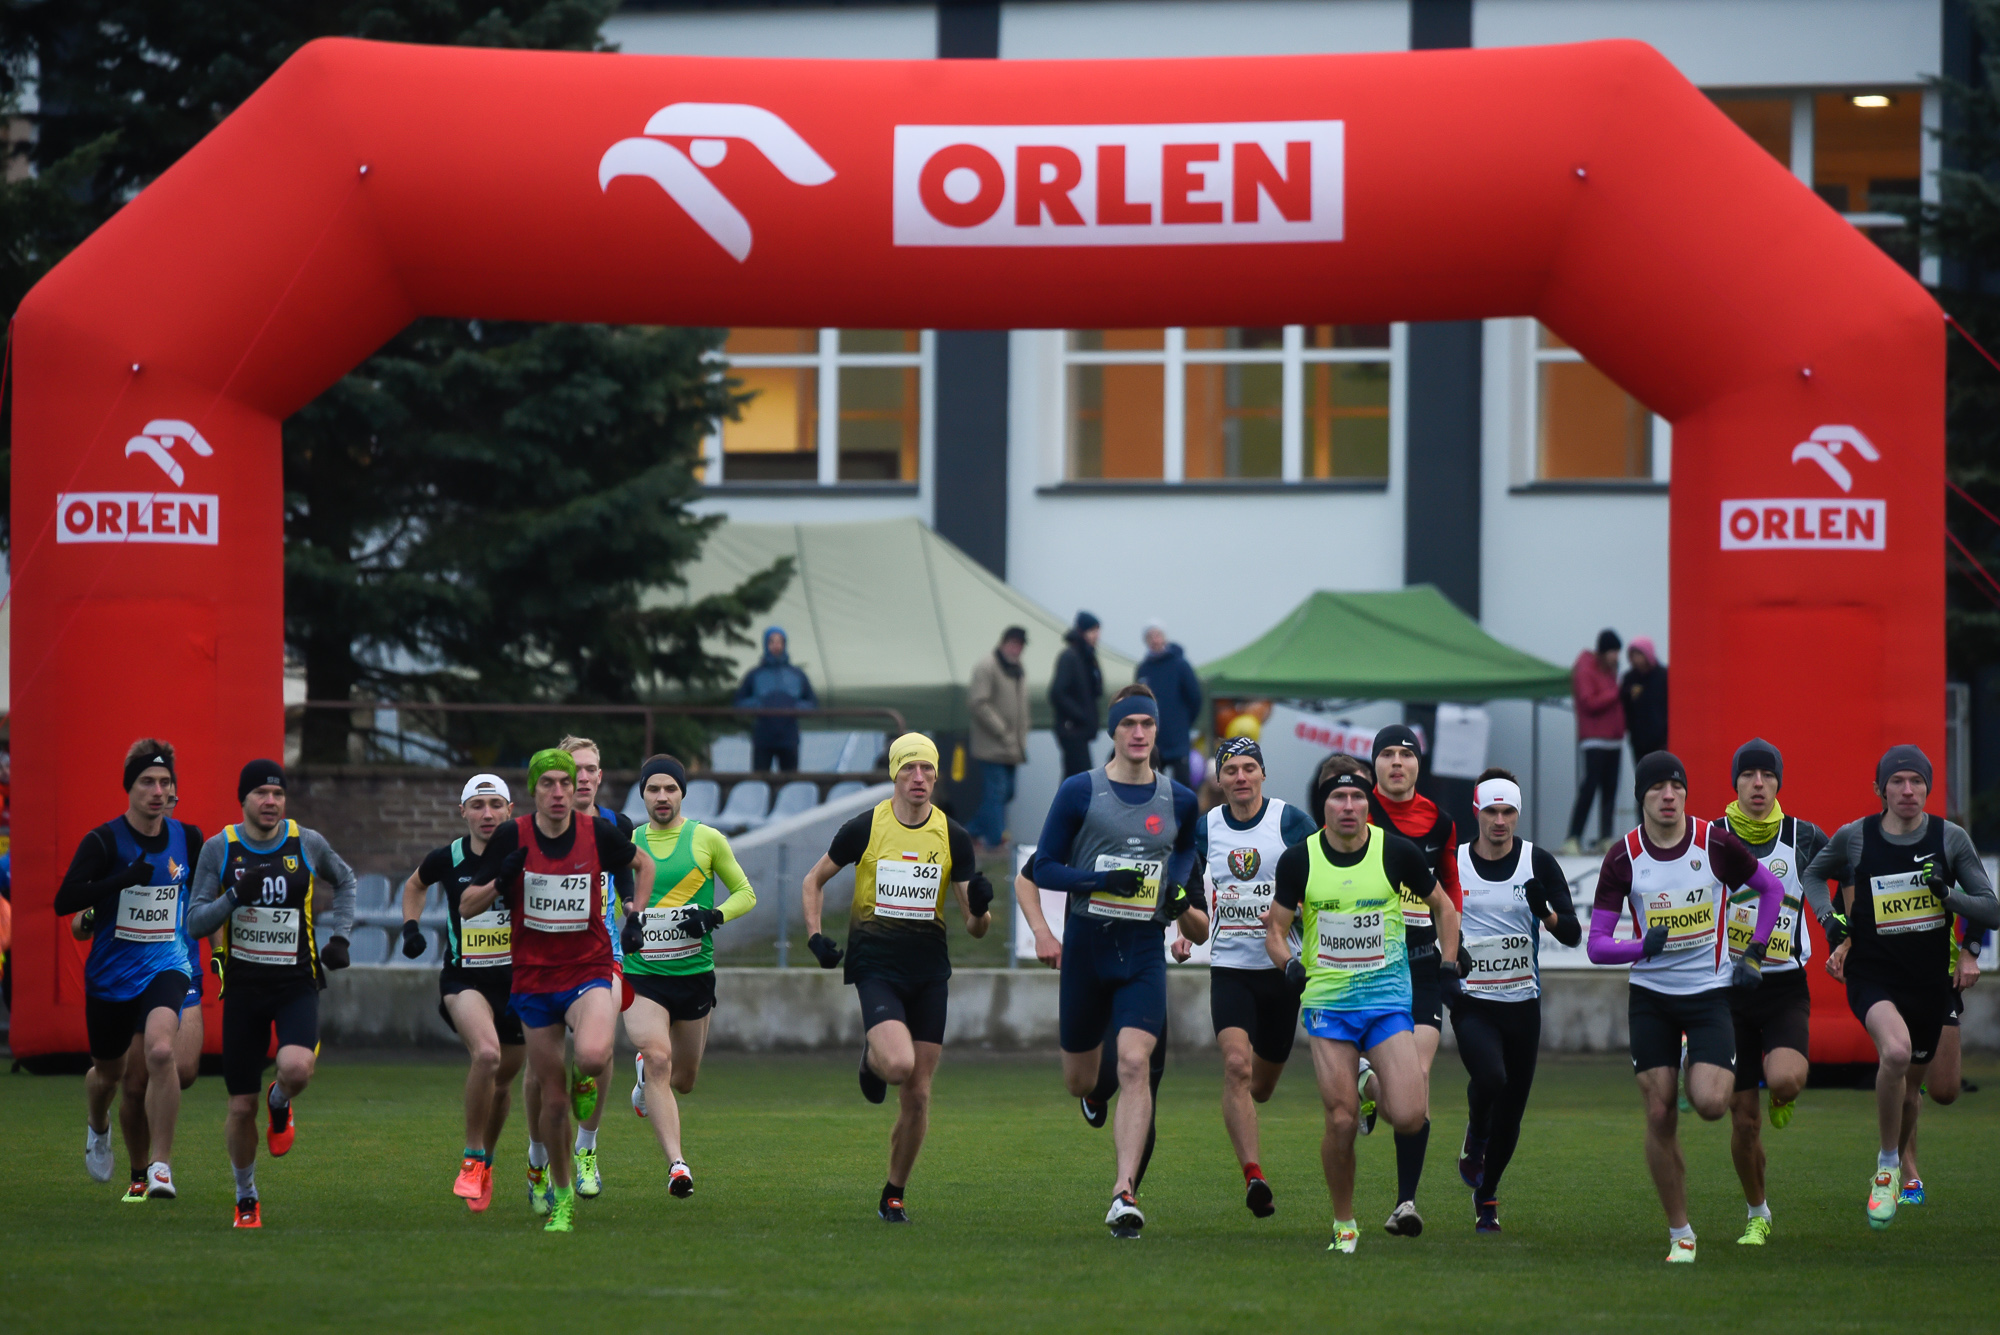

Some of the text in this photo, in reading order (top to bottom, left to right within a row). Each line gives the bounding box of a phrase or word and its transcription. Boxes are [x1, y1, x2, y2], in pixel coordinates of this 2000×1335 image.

[917, 139, 1312, 229] ORLEN
[64, 500, 208, 536] ORLEN
[1729, 507, 1875, 542] ORLEN
[912, 865, 938, 880] 362
[252, 876, 288, 906] 09
[560, 877, 587, 891] 475
[878, 883, 937, 900] KUJAWSKI
[1252, 883, 1271, 897] 48
[155, 887, 176, 901] 250
[1685, 888, 1704, 904] 47
[529, 896, 585, 912] LEPIARZ
[1882, 894, 1939, 915] KRYZEL
[128, 907, 169, 922] TABOR
[272, 910, 291, 924] 57
[1353, 913, 1380, 929] 333
[1649, 908, 1712, 929] CZERONEK
[234, 927, 297, 944] GOSIEWSKI
[466, 931, 512, 947] LIPIŃS
[1320, 934, 1382, 952] DĄBROWSKI
[1501, 935, 1529, 950] 309
[1470, 956, 1529, 973] PELCZAR
